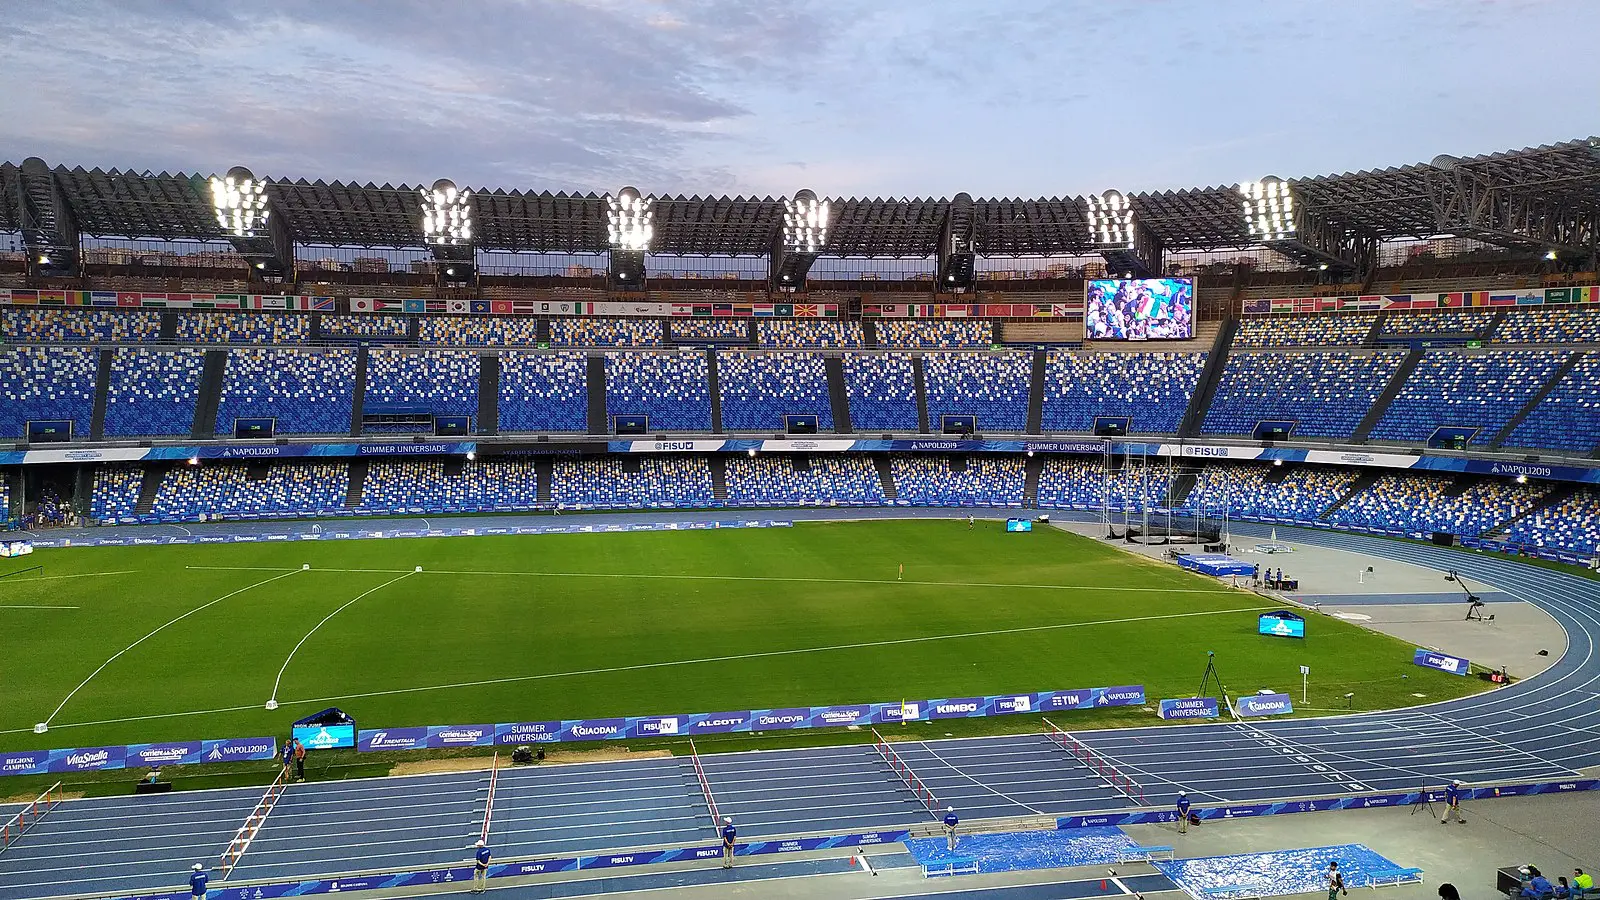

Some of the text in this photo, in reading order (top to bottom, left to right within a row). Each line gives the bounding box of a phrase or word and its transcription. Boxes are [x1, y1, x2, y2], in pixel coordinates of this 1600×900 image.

[398, 445, 447, 453] UNIVERSIADE
[655, 442, 685, 450] @FISU
[1027, 443, 1105, 452] SUMMER UNIVERSIADE
[232, 447, 279, 456] NAPOLI2019
[1185, 447, 1219, 456] @FISU
[1501, 464, 1551, 477] NAPOLI2019
[1428, 656, 1453, 667] FISU.TV
[1061, 695, 1079, 705] TIM
[1108, 691, 1140, 701] NAPOLI2019
[936, 703, 977, 714] KIMBO
[1000, 701, 1025, 709] FISU.TV
[1175, 701, 1204, 709] SUMMER
[1255, 701, 1285, 711] QIAODAN
[1169, 708, 1212, 717] UNIVERSIADE
[697, 718, 744, 727] ALCOTT
[767, 715, 804, 724] GIVOVA
[511, 725, 545, 734] SUMMER
[579, 726, 617, 736] QIAODAN
[643, 722, 672, 731] FISU.TV
[502, 732, 553, 743] UNIVERSIADE
[223, 744, 268, 755] NAPOLI2019
[6, 757, 35, 765] REGIONE
[66, 750, 108, 766] VitaSnella
[3, 763, 36, 771] CAMPANIA
[611, 856, 634, 864] FISU.TV
[521, 864, 545, 872] FISU.TV
